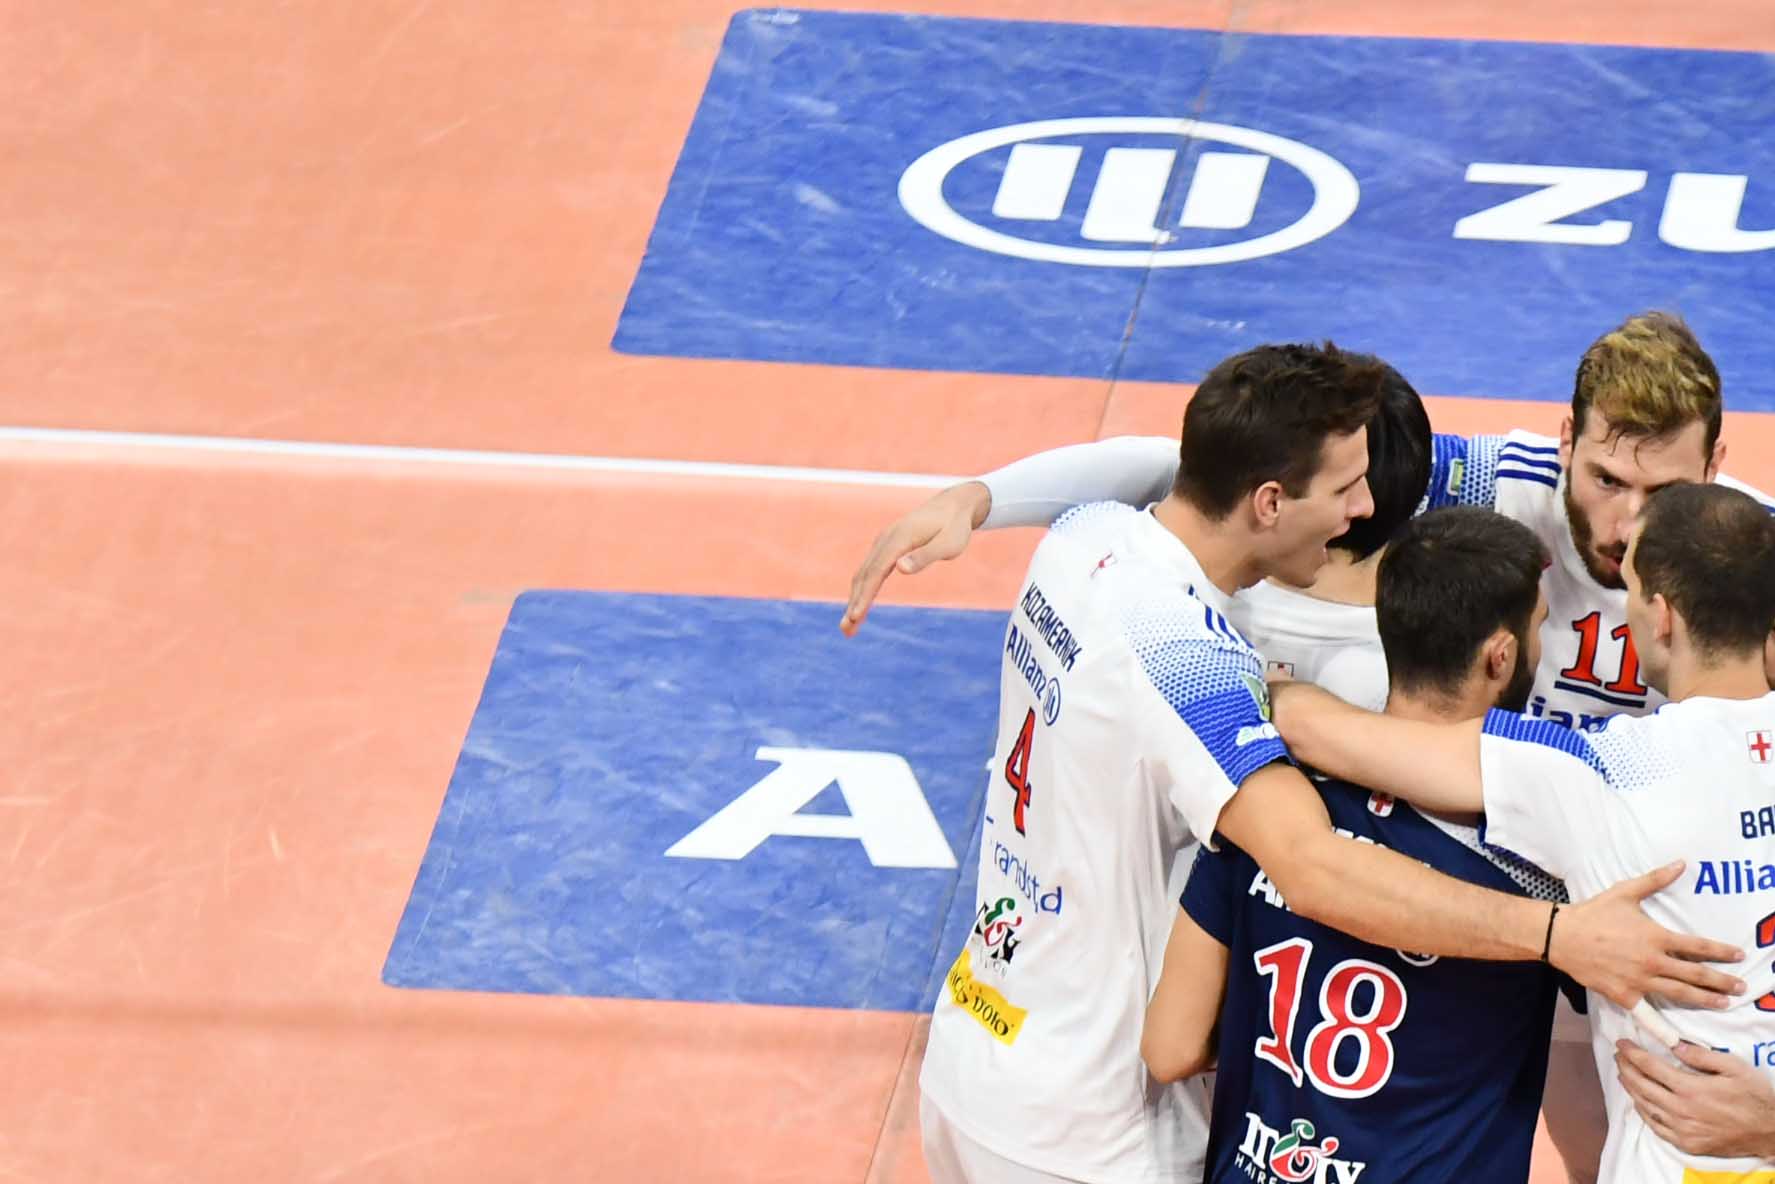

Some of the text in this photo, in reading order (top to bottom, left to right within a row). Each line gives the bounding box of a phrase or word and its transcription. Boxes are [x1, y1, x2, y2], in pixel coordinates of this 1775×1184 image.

[1006, 624, 1046, 700] Allianz
[1020, 582, 1082, 672] KOZAMERNIK
[1560, 611, 1648, 696] 11
[665, 747, 960, 869] A
[1005, 706, 1036, 838] 4
[994, 841, 1063, 915] randstd
[1254, 937, 1408, 1099] 18
